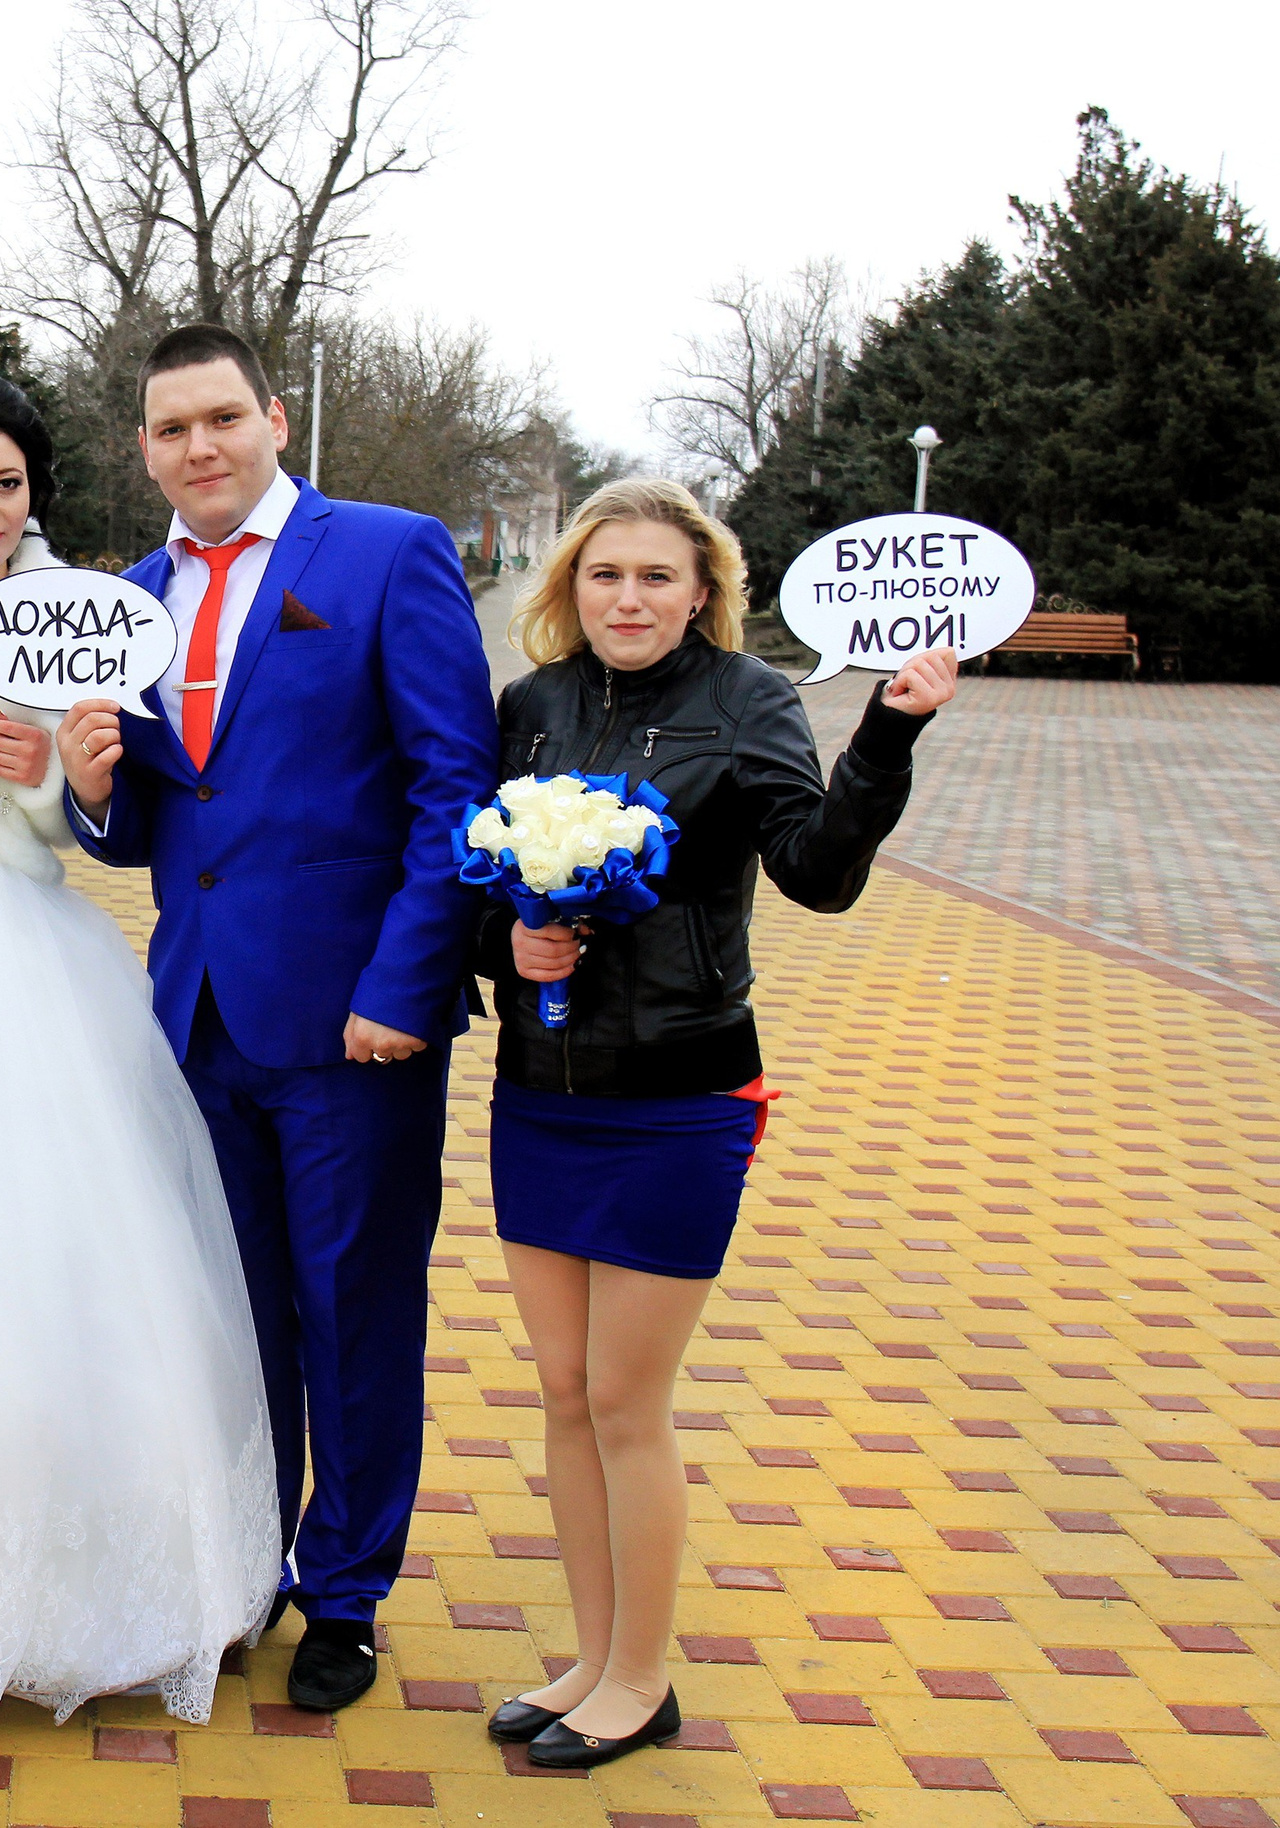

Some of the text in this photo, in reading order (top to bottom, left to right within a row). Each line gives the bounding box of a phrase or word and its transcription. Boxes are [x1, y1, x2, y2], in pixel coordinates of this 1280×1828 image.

[836, 533, 979, 572] БУКЕТ
[813, 576, 1001, 605] ПО-ЛЮБОМУ
[848, 604, 966, 654] МОЙ!
[8, 645, 127, 687] ЛИСЬ!
